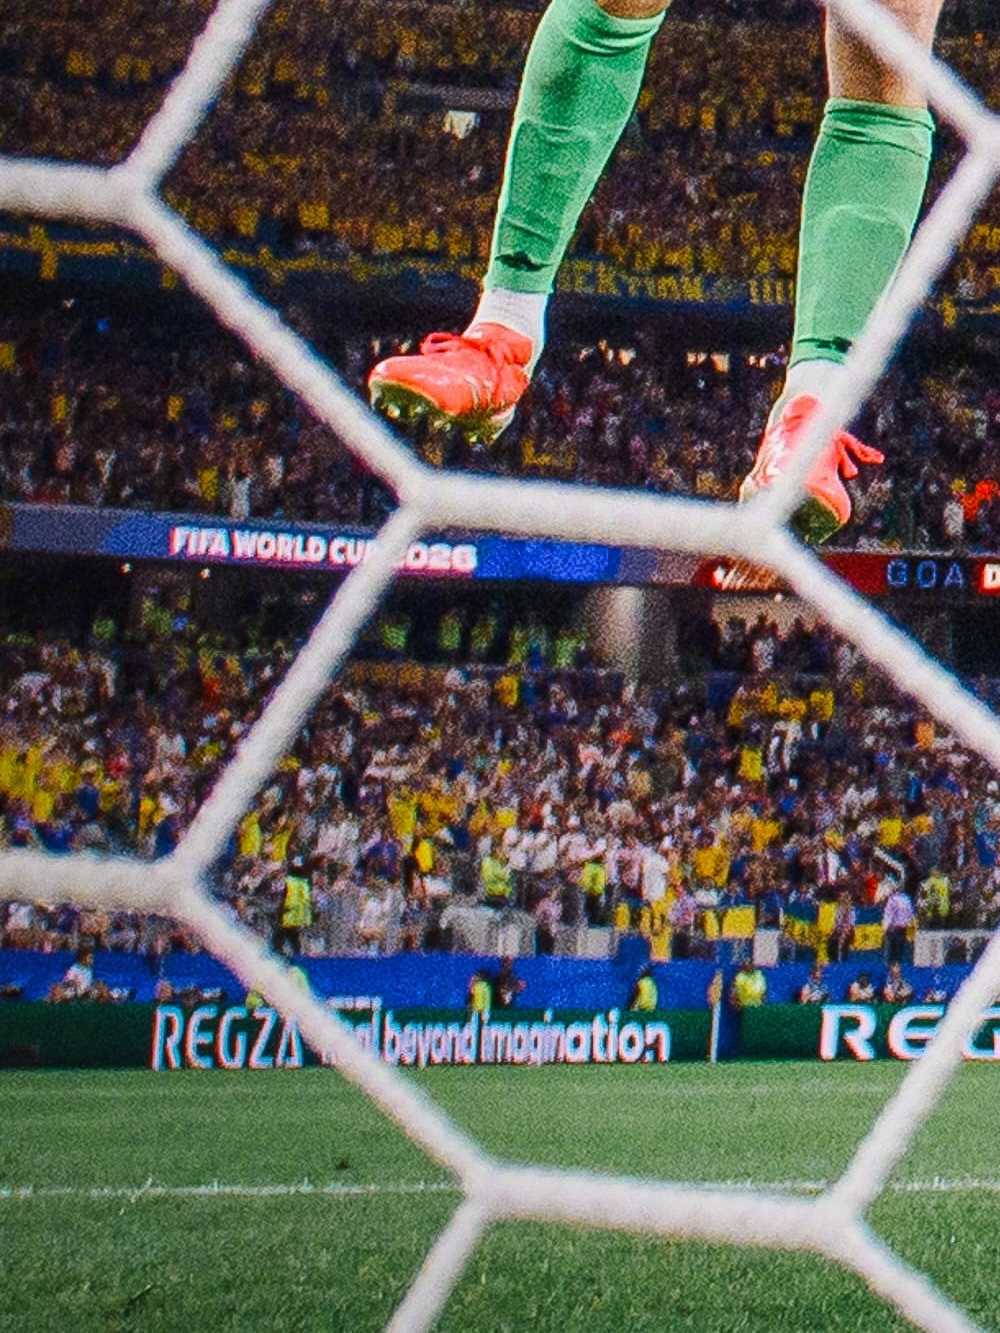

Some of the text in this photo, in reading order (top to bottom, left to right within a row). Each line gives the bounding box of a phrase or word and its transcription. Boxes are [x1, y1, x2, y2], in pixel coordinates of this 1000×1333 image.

[169, 525, 230, 558] FIFA
[232, 529, 329, 563] WORLD
[398, 540, 478, 573] 026
[886, 558, 965, 588] GOA
[152, 1004, 304, 1071] REGZA
[382, 1010, 478, 1069] beyond
